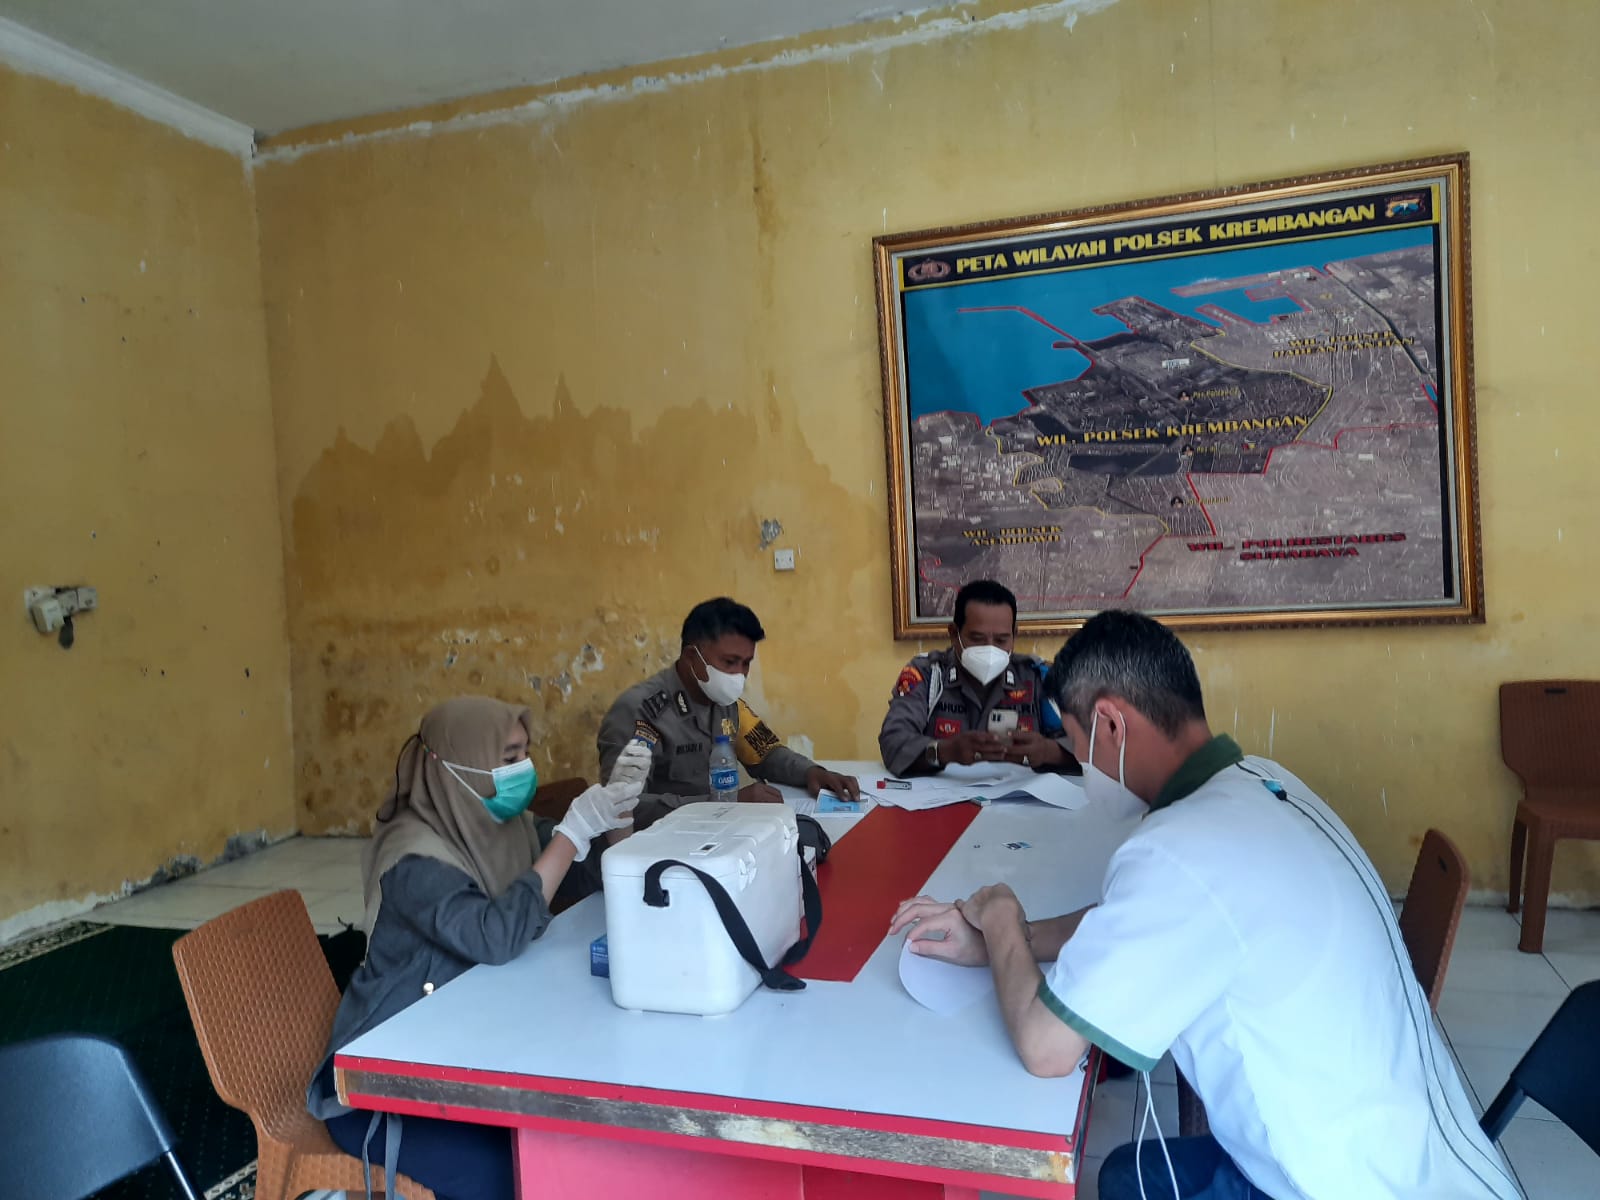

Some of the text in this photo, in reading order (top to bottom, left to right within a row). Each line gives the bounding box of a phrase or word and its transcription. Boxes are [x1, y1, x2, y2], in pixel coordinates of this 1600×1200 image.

[956, 203, 1376, 274] PETA WILAYAH POLSEK KREMBANGAN
[1036, 415, 1309, 447] WIL. POLSEK KREMBANGAN
